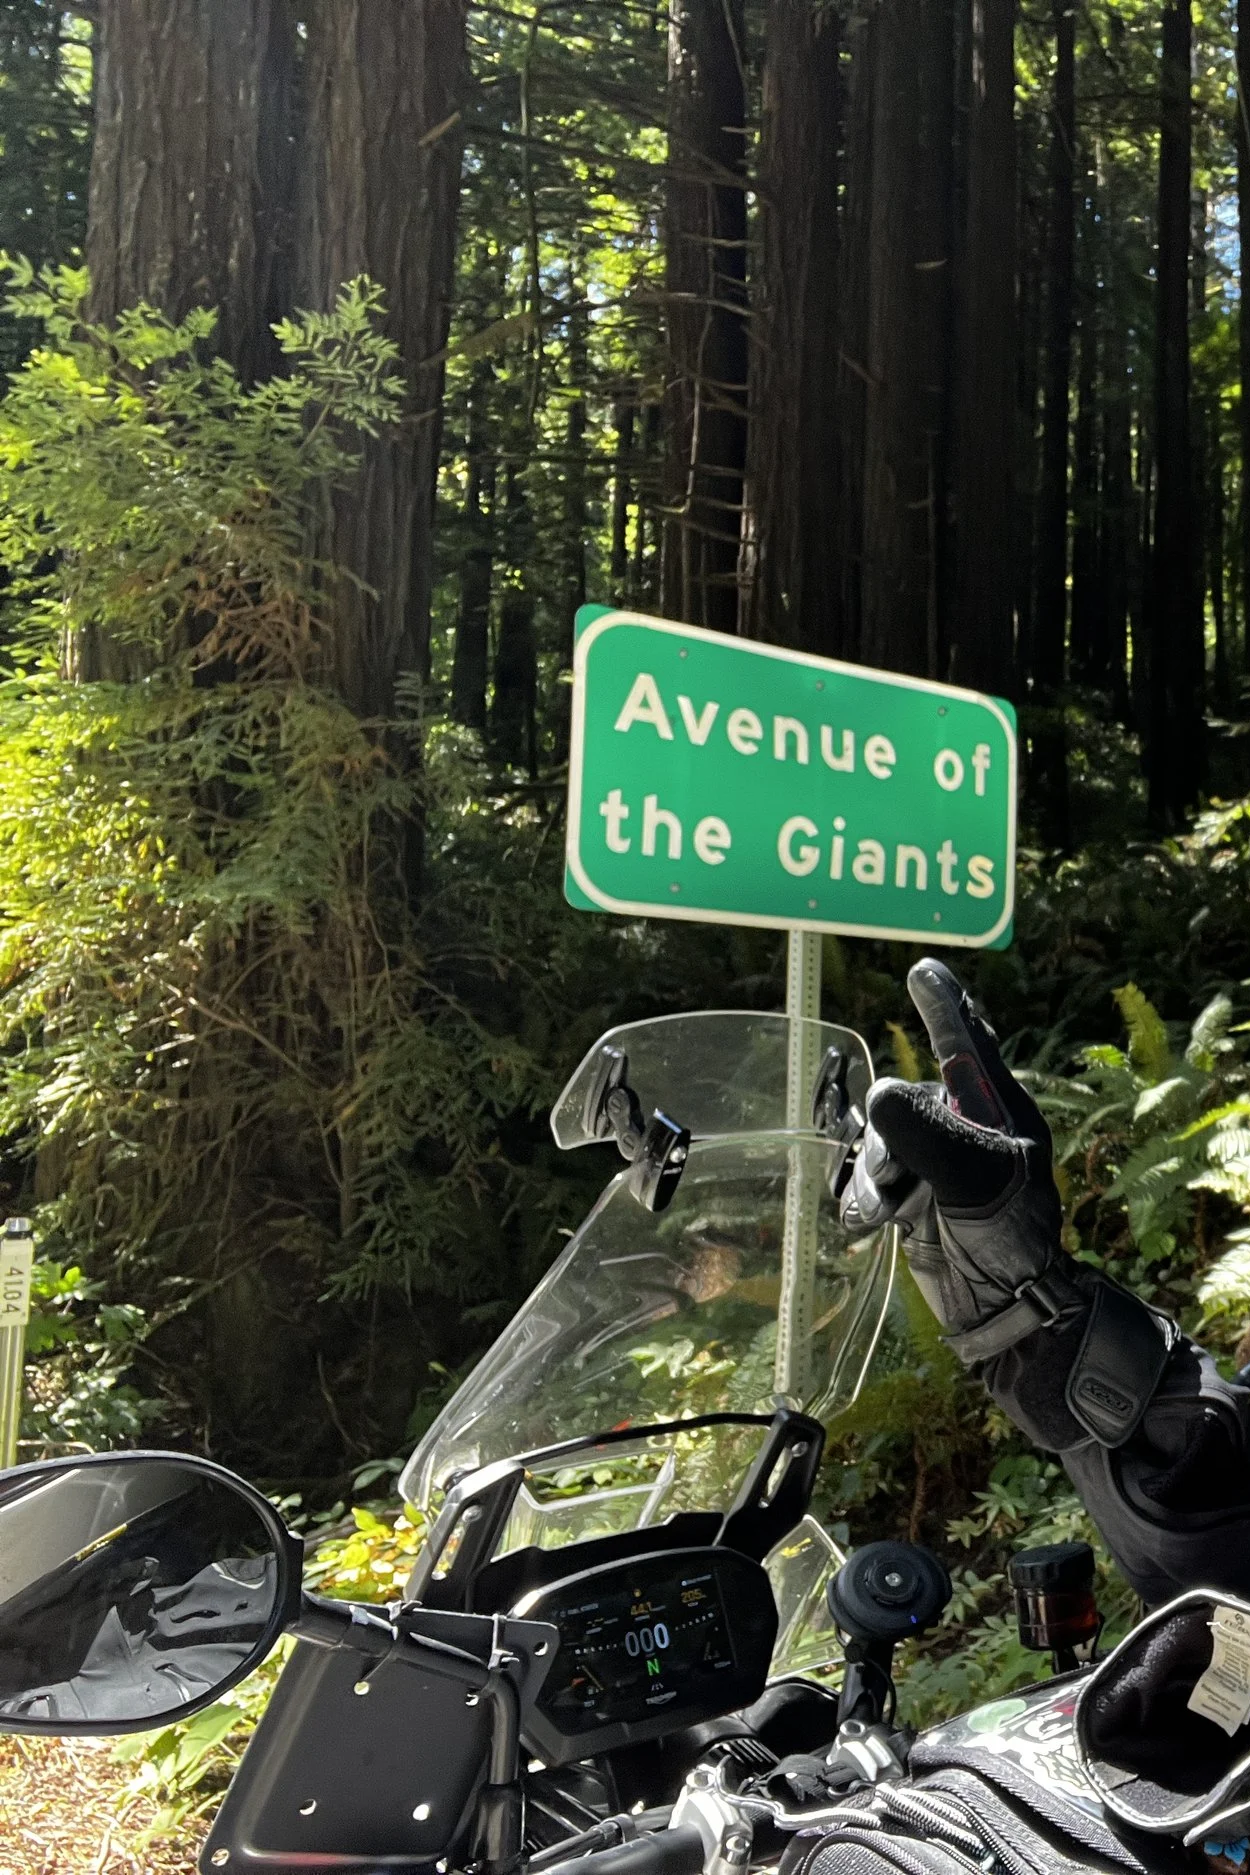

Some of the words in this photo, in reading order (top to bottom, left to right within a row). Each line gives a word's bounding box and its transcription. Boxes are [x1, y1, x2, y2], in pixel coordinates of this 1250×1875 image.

[614, 672, 897, 780] Avenue
[933, 743, 991, 797] of
[599, 788, 732, 866] the
[777, 815, 996, 900] Giants
[625, 1623, 669, 1656] 000
[647, 1659, 660, 1675] N
